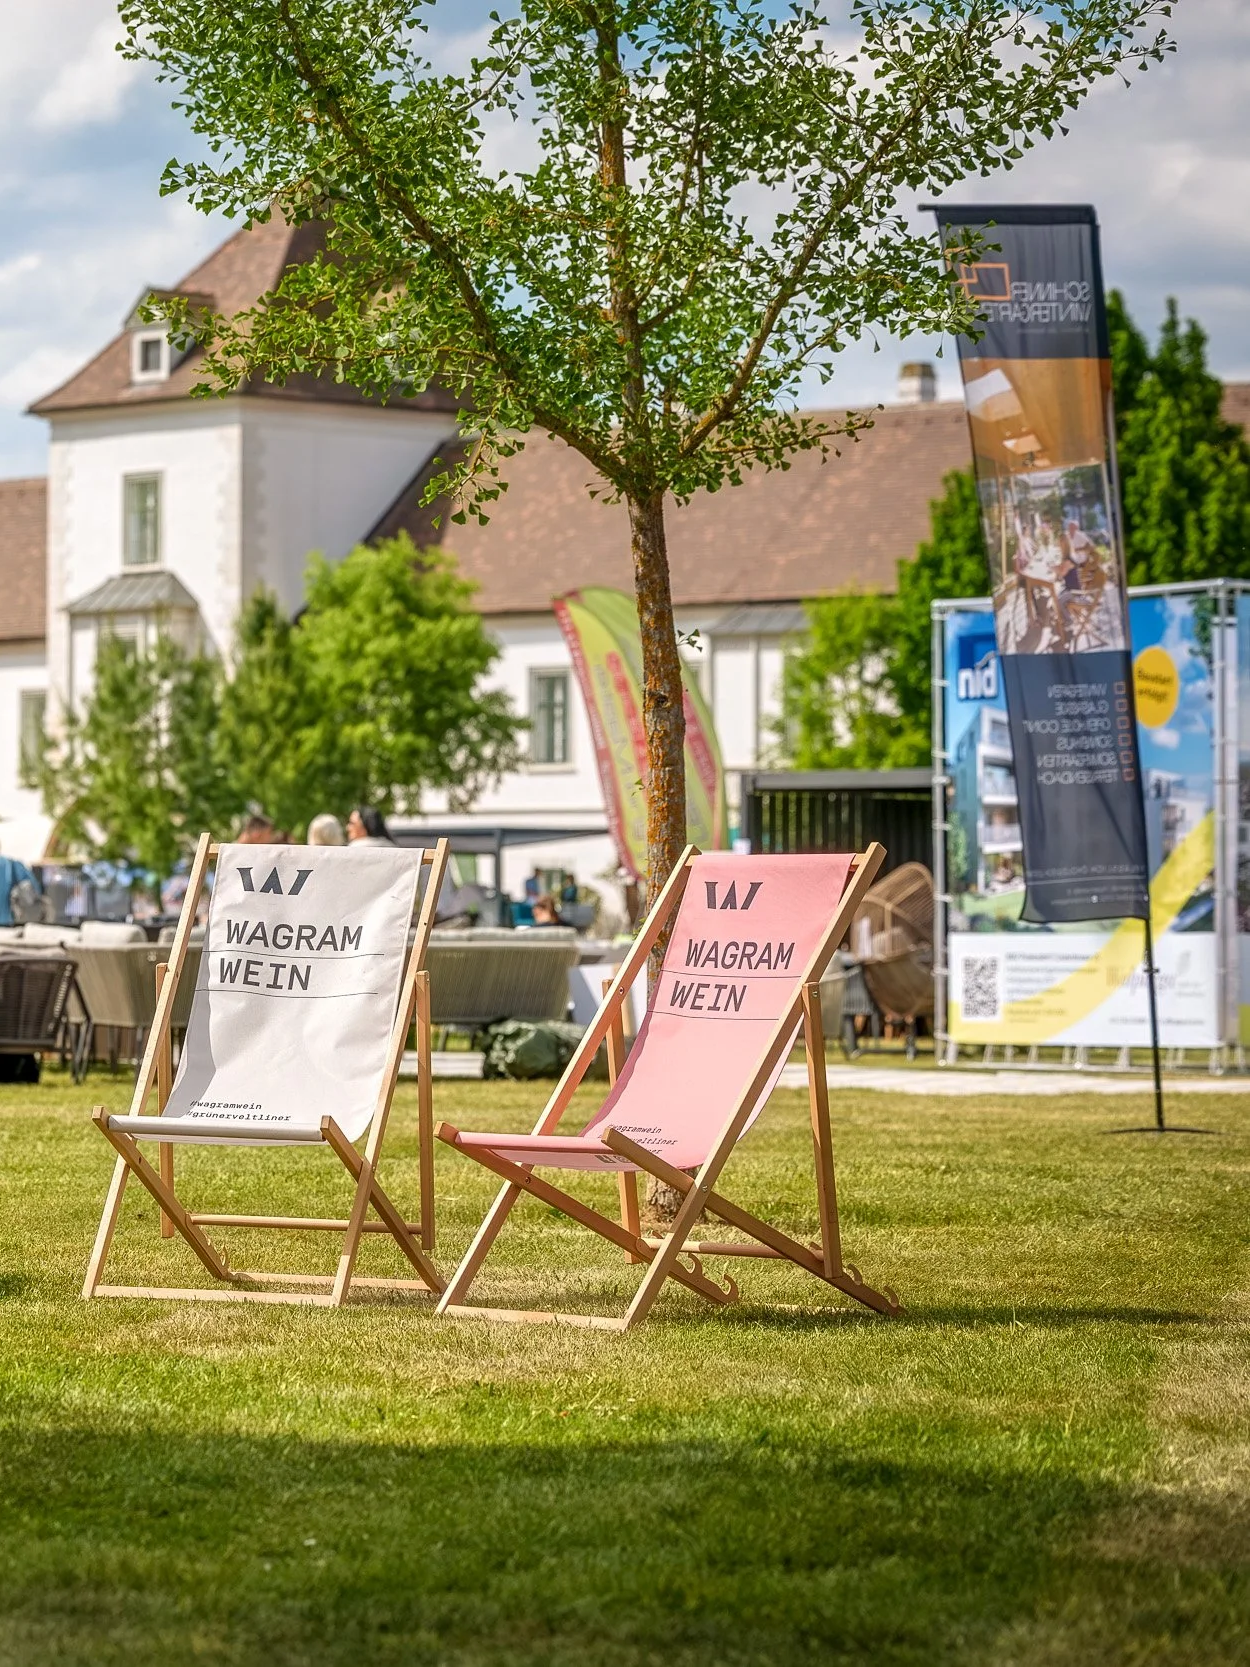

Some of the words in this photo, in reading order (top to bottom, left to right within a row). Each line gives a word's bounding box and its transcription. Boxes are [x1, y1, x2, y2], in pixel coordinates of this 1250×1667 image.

[226, 919, 363, 952] WAGRAM
[685, 938, 795, 970] WAGRAM
[219, 957, 312, 991] WEIN
[670, 980, 747, 1012] WEIN
[186, 1110, 292, 1122] #grünerveltliner
[189, 1099, 262, 1110] #wagramwein
